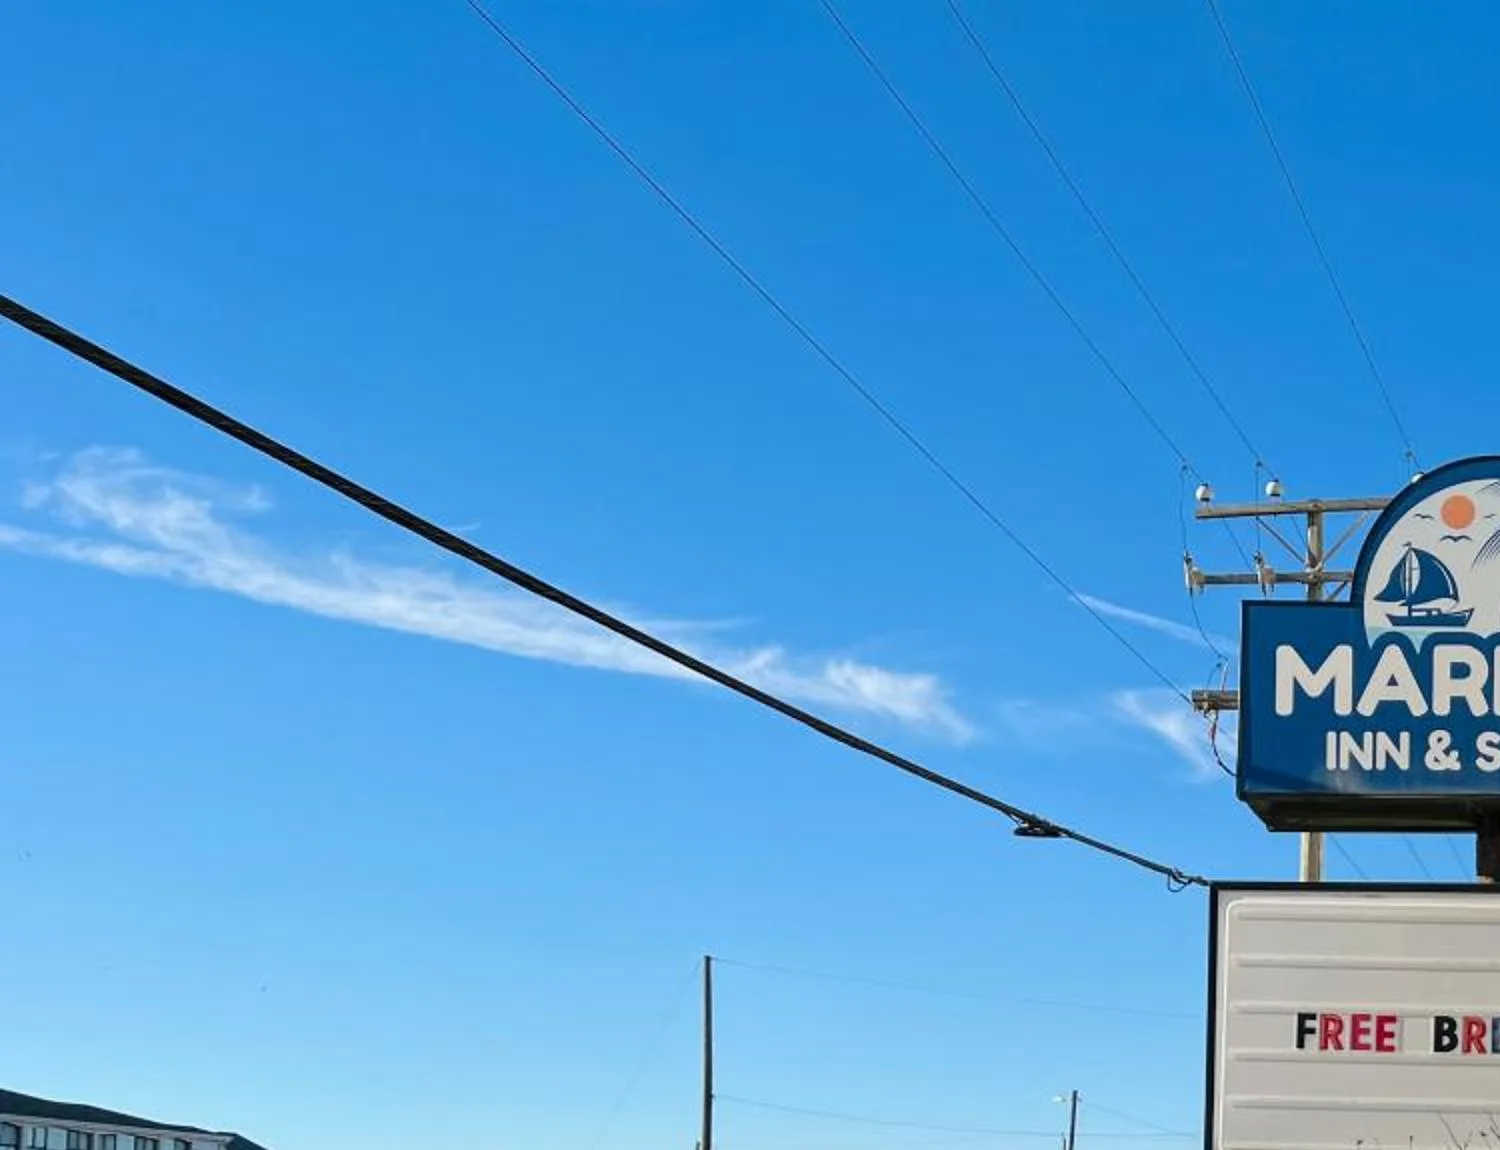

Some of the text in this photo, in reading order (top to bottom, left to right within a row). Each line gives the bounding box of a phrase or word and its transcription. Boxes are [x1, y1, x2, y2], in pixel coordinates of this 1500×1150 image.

[1325, 731, 1409, 771] INN
[1424, 729, 1461, 771] &
[1296, 1012, 1398, 1053] FREE
